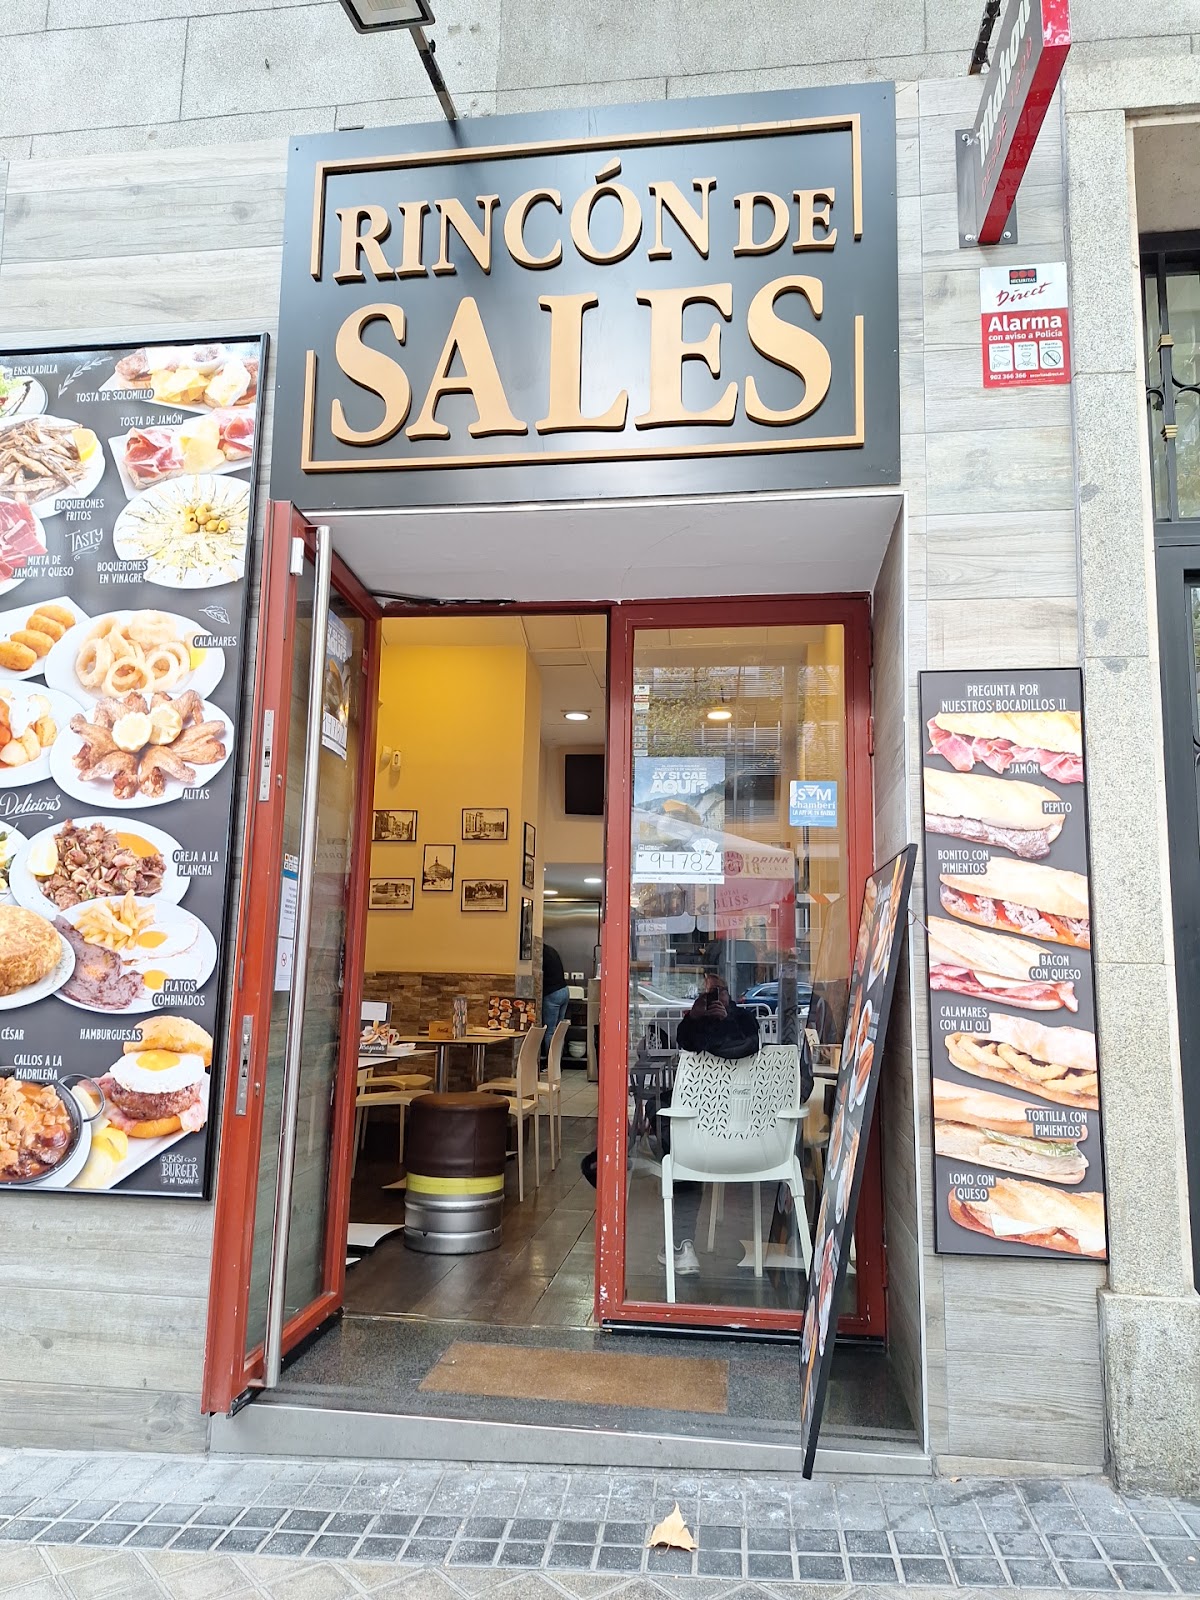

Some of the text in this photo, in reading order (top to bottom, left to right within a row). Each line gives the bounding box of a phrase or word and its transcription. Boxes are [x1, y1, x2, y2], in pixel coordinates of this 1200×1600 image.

[332, 155, 839, 283] RINCÓN DE
[996, 283, 1052, 306] Direct
[988, 315, 1062, 332] Alarma
[1005, 332, 1027, 340] aviso
[1035, 329, 1063, 339] Policía
[331, 274, 832, 446] SALES
[13, 364, 58, 376] ENSALADILLA
[76, 389, 154, 403] TOSTA DE SOLOMILLO
[120, 414, 184, 427] TOSTA DE JAMÓN
[56, 499, 105, 510] BOQUERONES
[66, 511, 92, 521] FRITOS
[27, 555, 61, 565] MIXTA DE
[13, 566, 74, 578] JAMÓN Y QUESO
[97, 561, 147, 572] BOQUERONES
[99, 573, 143, 584] EN VINAGRE
[194, 636, 237, 647] CALAMARES
[967, 684, 1039, 698] PREGUNTA POR
[941, 700, 993, 712] NUESTROS
[996, 699, 1056, 711] BOCADILLOS
[1010, 762, 1039, 774] JAMÓN
[668, 771, 680, 780] SI
[681, 771, 707, 780] CAE
[183, 789, 210, 800] ALITAS
[1043, 802, 1072, 813] PEPITO
[174, 851, 219, 862] OREJA A LA
[751, 856, 790, 864] DRINK
[937, 849, 989, 861] BONITO CON
[650, 852, 717, 871] 94782
[177, 864, 212, 875] PLANCHA
[942, 862, 986, 874] PIMIENTOS
[713, 894, 750, 909] BLISS
[1041, 954, 1069, 967] BACON
[1030, 967, 1081, 980] CON QUESO
[165, 981, 196, 992] PLATOS
[153, 994, 205, 1005] COMBINADOS
[940, 1006, 988, 1018] CALAMARES
[939, 1019, 989, 1032] CON ALI OLI
[1, 1027, 24, 1040] CÉSAR
[80, 1028, 142, 1040] HAMBURGUESAS
[14, 1054, 63, 1067] CALLOS A LA
[15, 1067, 58, 1081] MADRILEÑA
[1026, 1110, 1087, 1123] TORTILLA CON
[1035, 1124, 1081, 1137] PIMIENTOS
[161, 1163, 199, 1178] BURGER
[949, 1173, 994, 1186] LOMO CON
[956, 1188, 988, 1200] QUESO
